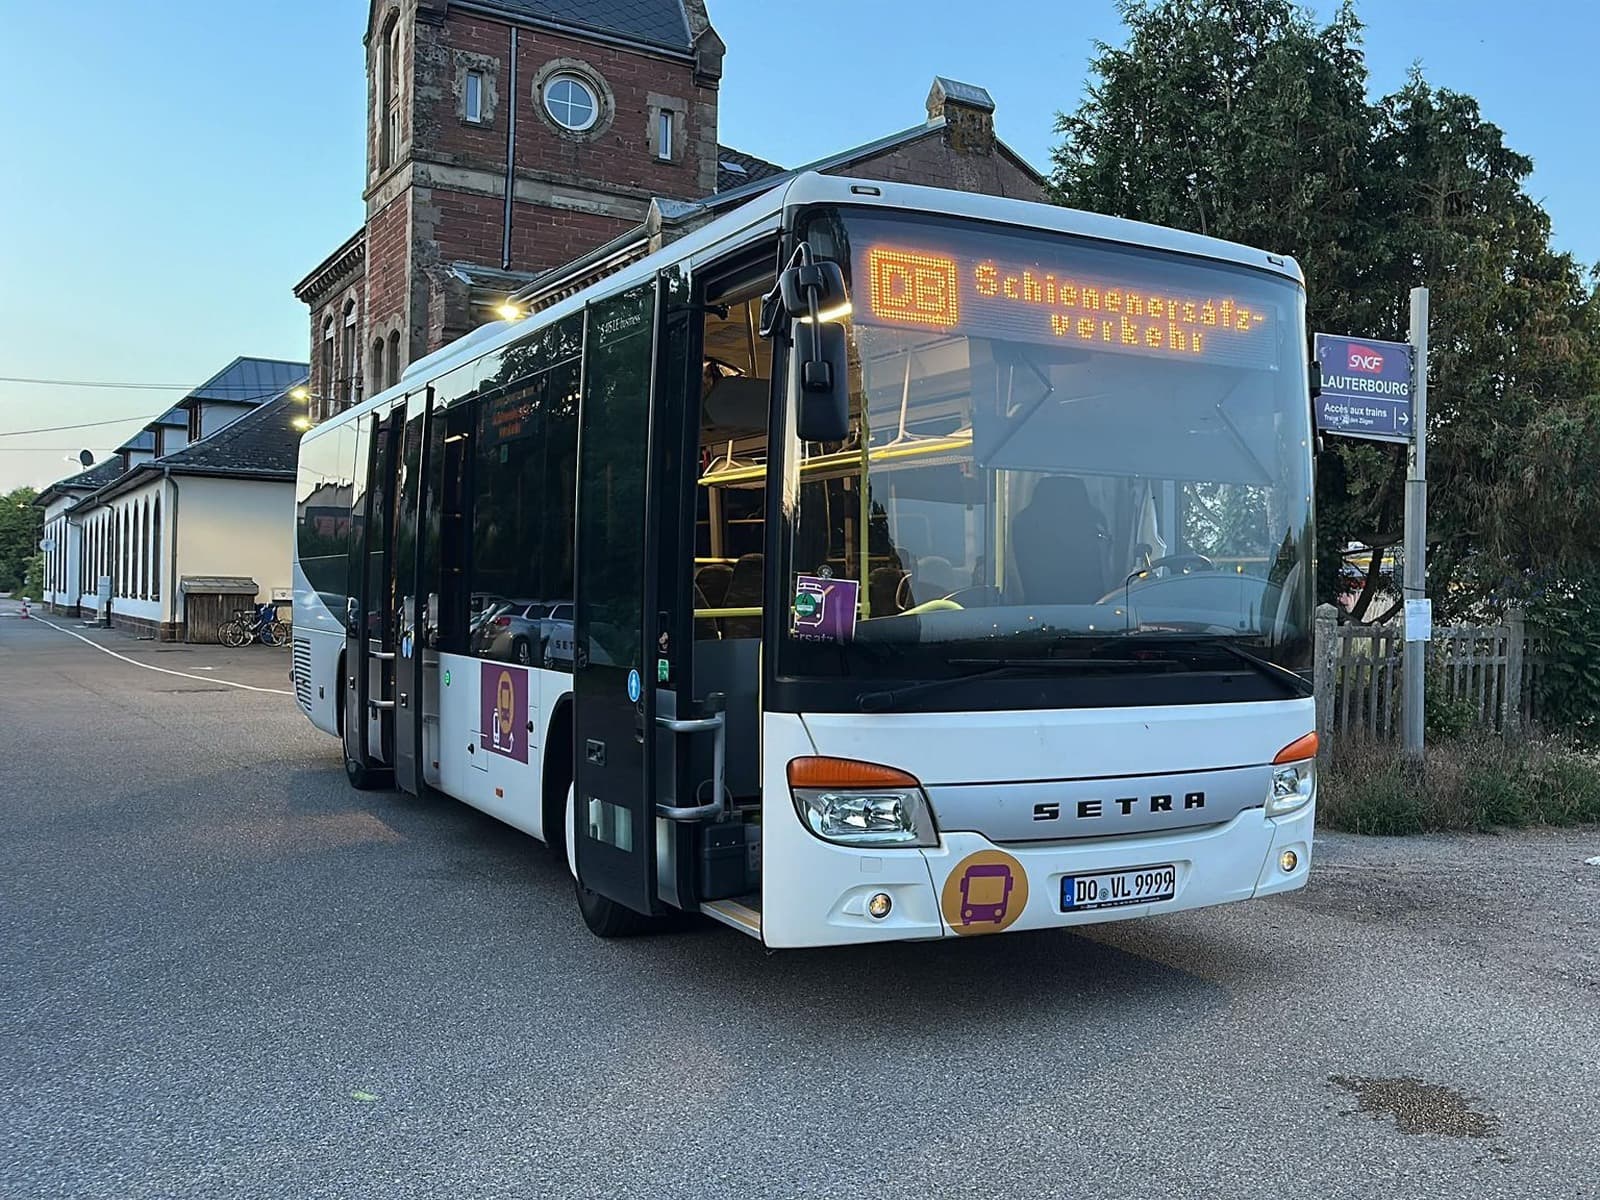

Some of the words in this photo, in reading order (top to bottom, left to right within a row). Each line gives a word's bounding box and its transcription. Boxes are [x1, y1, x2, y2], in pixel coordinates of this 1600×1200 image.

[974, 263, 1264, 331] Schienenersatz-
[1050, 312, 1204, 353] verkehr
[1349, 355, 1383, 370] SNCF
[1321, 374, 1409, 396] LAUTERBOURG
[1324, 402, 1348, 414] Accès
[1350, 407, 1364, 416] aux
[1365, 407, 1388, 418] trains
[1033, 791, 1205, 821] SETRA
[1076, 879, 1098, 902] DO
[1111, 876, 1131, 898] VL
[1135, 870, 1174, 896] 9999
